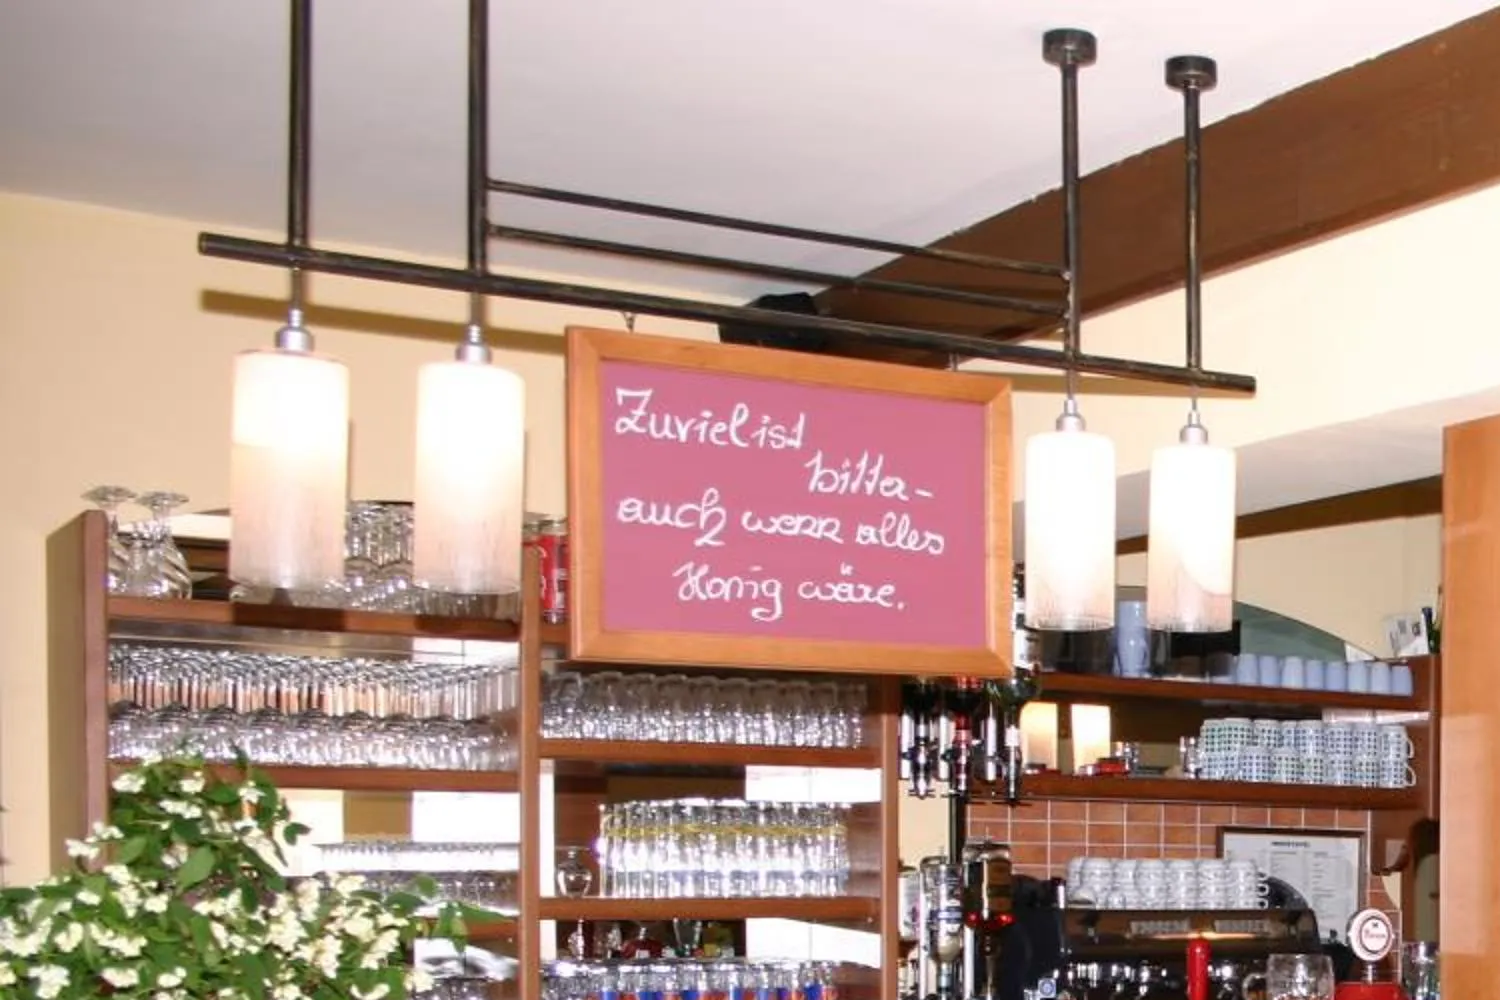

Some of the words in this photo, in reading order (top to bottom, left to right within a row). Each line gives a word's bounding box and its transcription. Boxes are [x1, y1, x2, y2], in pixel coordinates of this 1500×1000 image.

[616, 487, 726, 547] auch
[855, 511, 945, 555] alles
[672, 561, 783, 622] Honig
